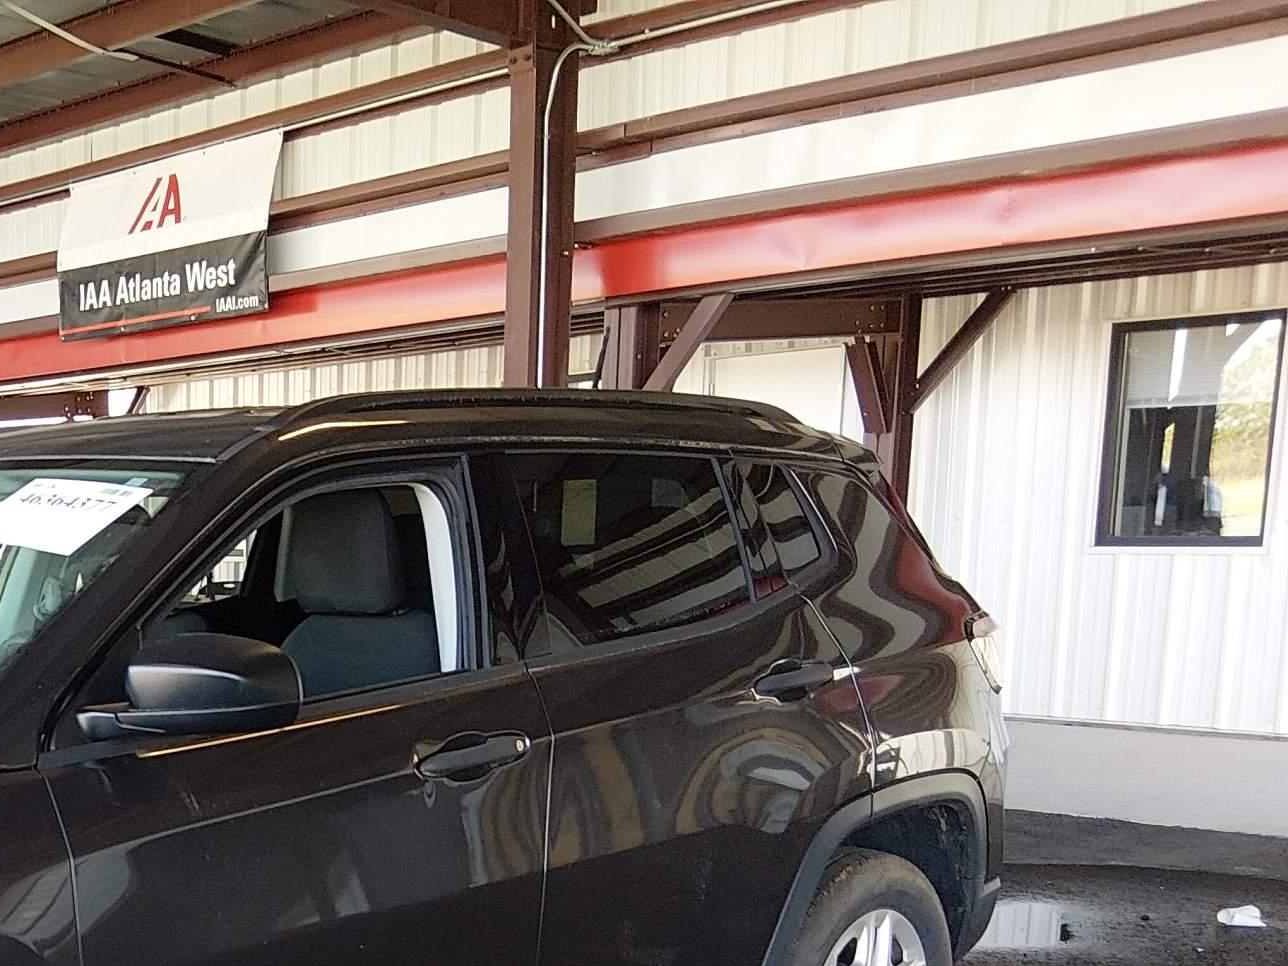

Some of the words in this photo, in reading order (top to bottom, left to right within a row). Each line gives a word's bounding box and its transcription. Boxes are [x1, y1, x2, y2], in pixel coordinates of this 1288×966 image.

[79, 279, 112, 312] IAA
[116, 271, 181, 305] Atlanta
[185, 257, 236, 293] West
[215, 294, 259, 313] IAAI.com
